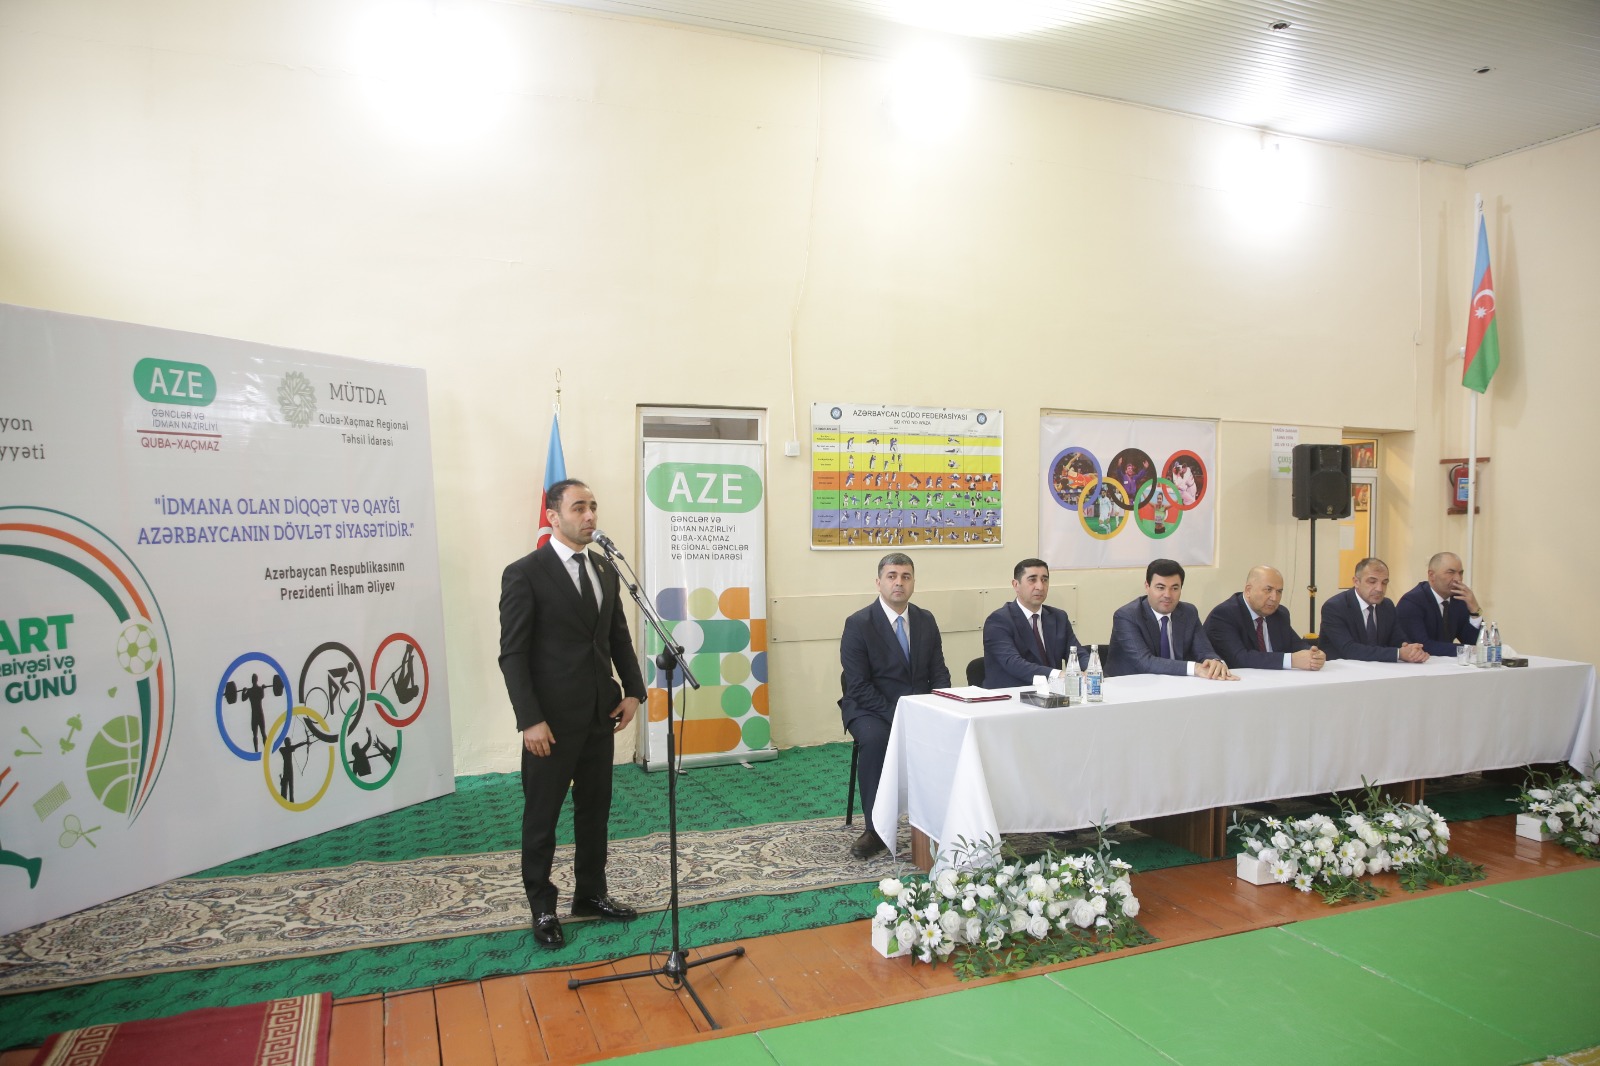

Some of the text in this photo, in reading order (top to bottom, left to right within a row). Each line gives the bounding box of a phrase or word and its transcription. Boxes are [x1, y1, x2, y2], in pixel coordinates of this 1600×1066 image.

[150, 367, 204, 399] AZE
[329, 381, 387, 406] MÜTDA
[151, 408, 205, 420] GƏNCLƏR VƏ
[319, 413, 409, 432] Quba-Xaçmaz Regional
[852, 410, 900, 418] AZƏRBAYCAN
[922, 412, 968, 421] FEDERASİYASI
[140, 436, 220, 453] QUBA-XAÇMAZ
[341, 433, 366, 445] Təhsil
[667, 471, 743, 505] AZE
[154, 494, 401, 517] "İDMANA OLAN DİQQƏT VƏ QAYĞI
[137, 526, 270, 545] AZƏRBAYCANIN
[274, 521, 332, 542] DÖVLƏT
[670, 524, 697, 532] İDMAN
[670, 534, 730, 543] QUBA-XAÇMAZ
[671, 543, 710, 551] REGİONAL
[684, 552, 710, 560] İDMAN
[712, 552, 743, 560] İDARƏSİ
[264, 560, 406, 581] Azərbaycan Respublikasının
[280, 580, 396, 601] Prezidenti İlham Əliyev
[54, 655, 76, 669] VƏ
[5, 670, 78, 704] GÜNÜ
